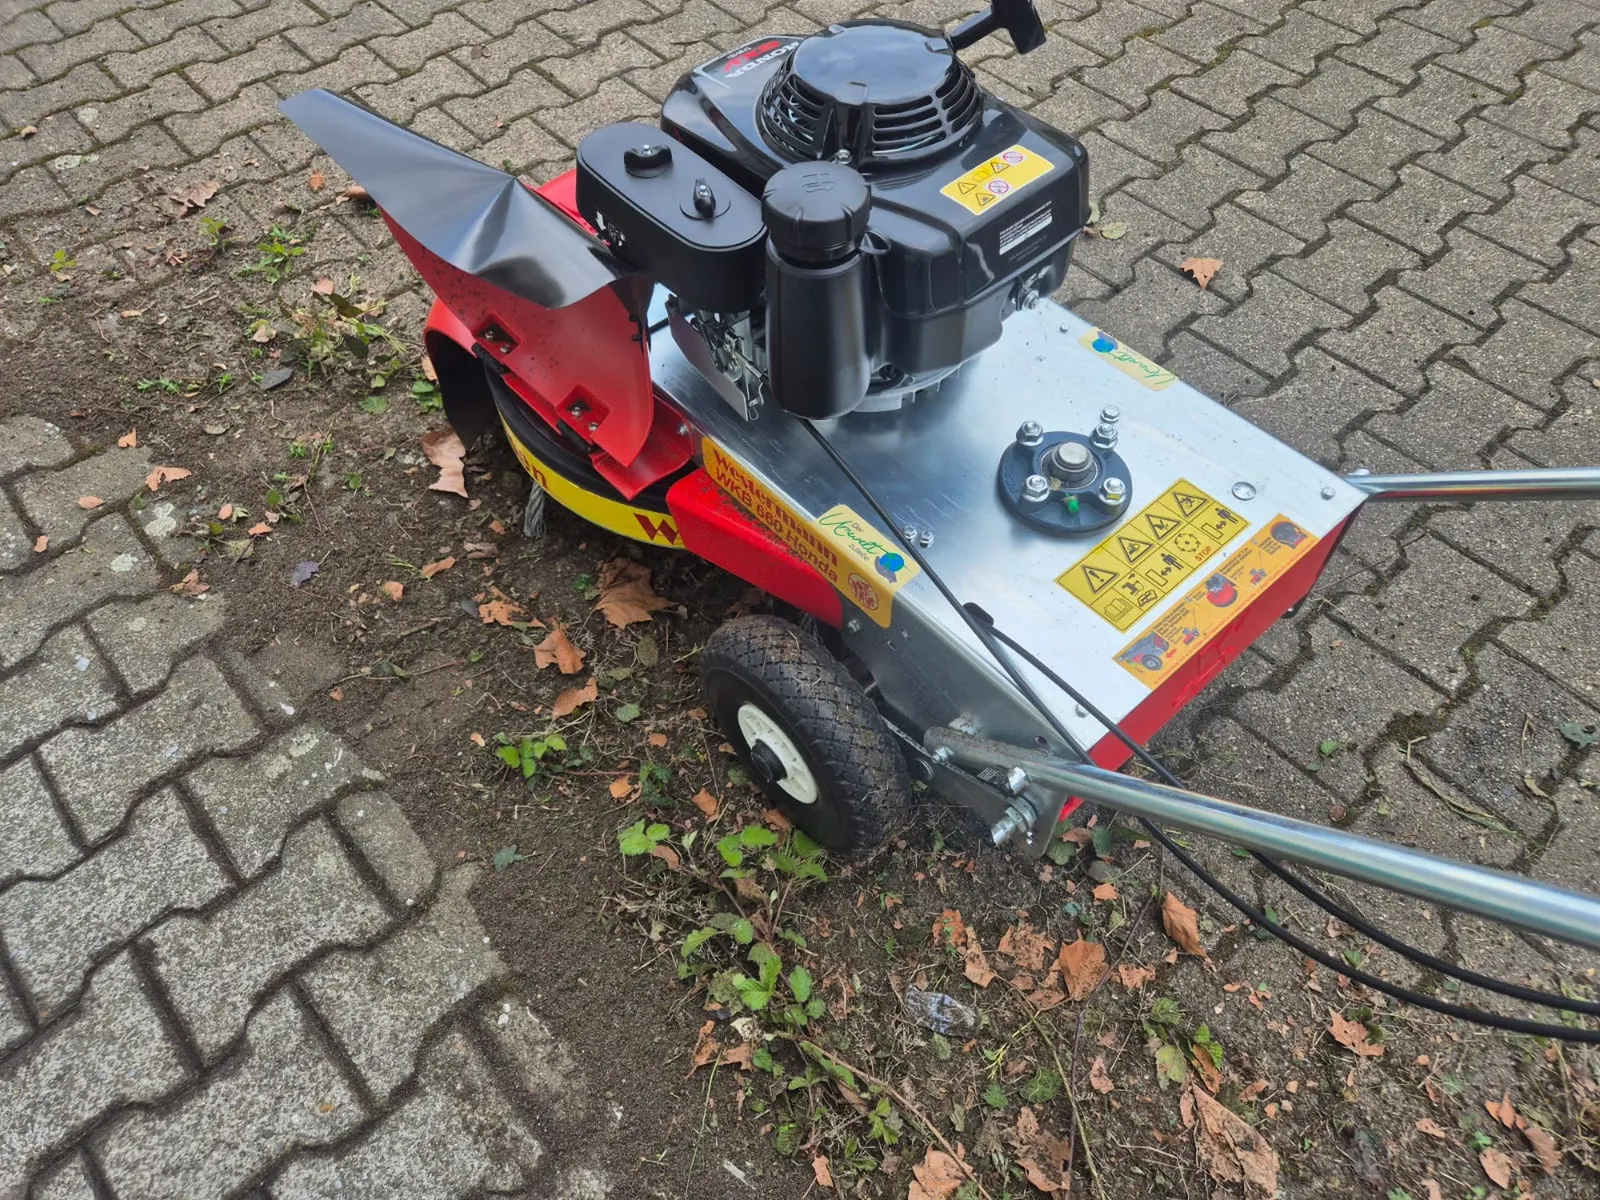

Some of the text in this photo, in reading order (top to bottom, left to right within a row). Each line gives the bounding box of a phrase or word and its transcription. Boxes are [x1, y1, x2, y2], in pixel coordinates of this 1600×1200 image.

[724, 42, 799, 78] HONDA
[713, 448, 838, 567] Westermann
[716, 467, 838, 582] WKB 660 Honda
[819, 512, 878, 555] Umwelt
[1194, 545, 1212, 562] STOP
